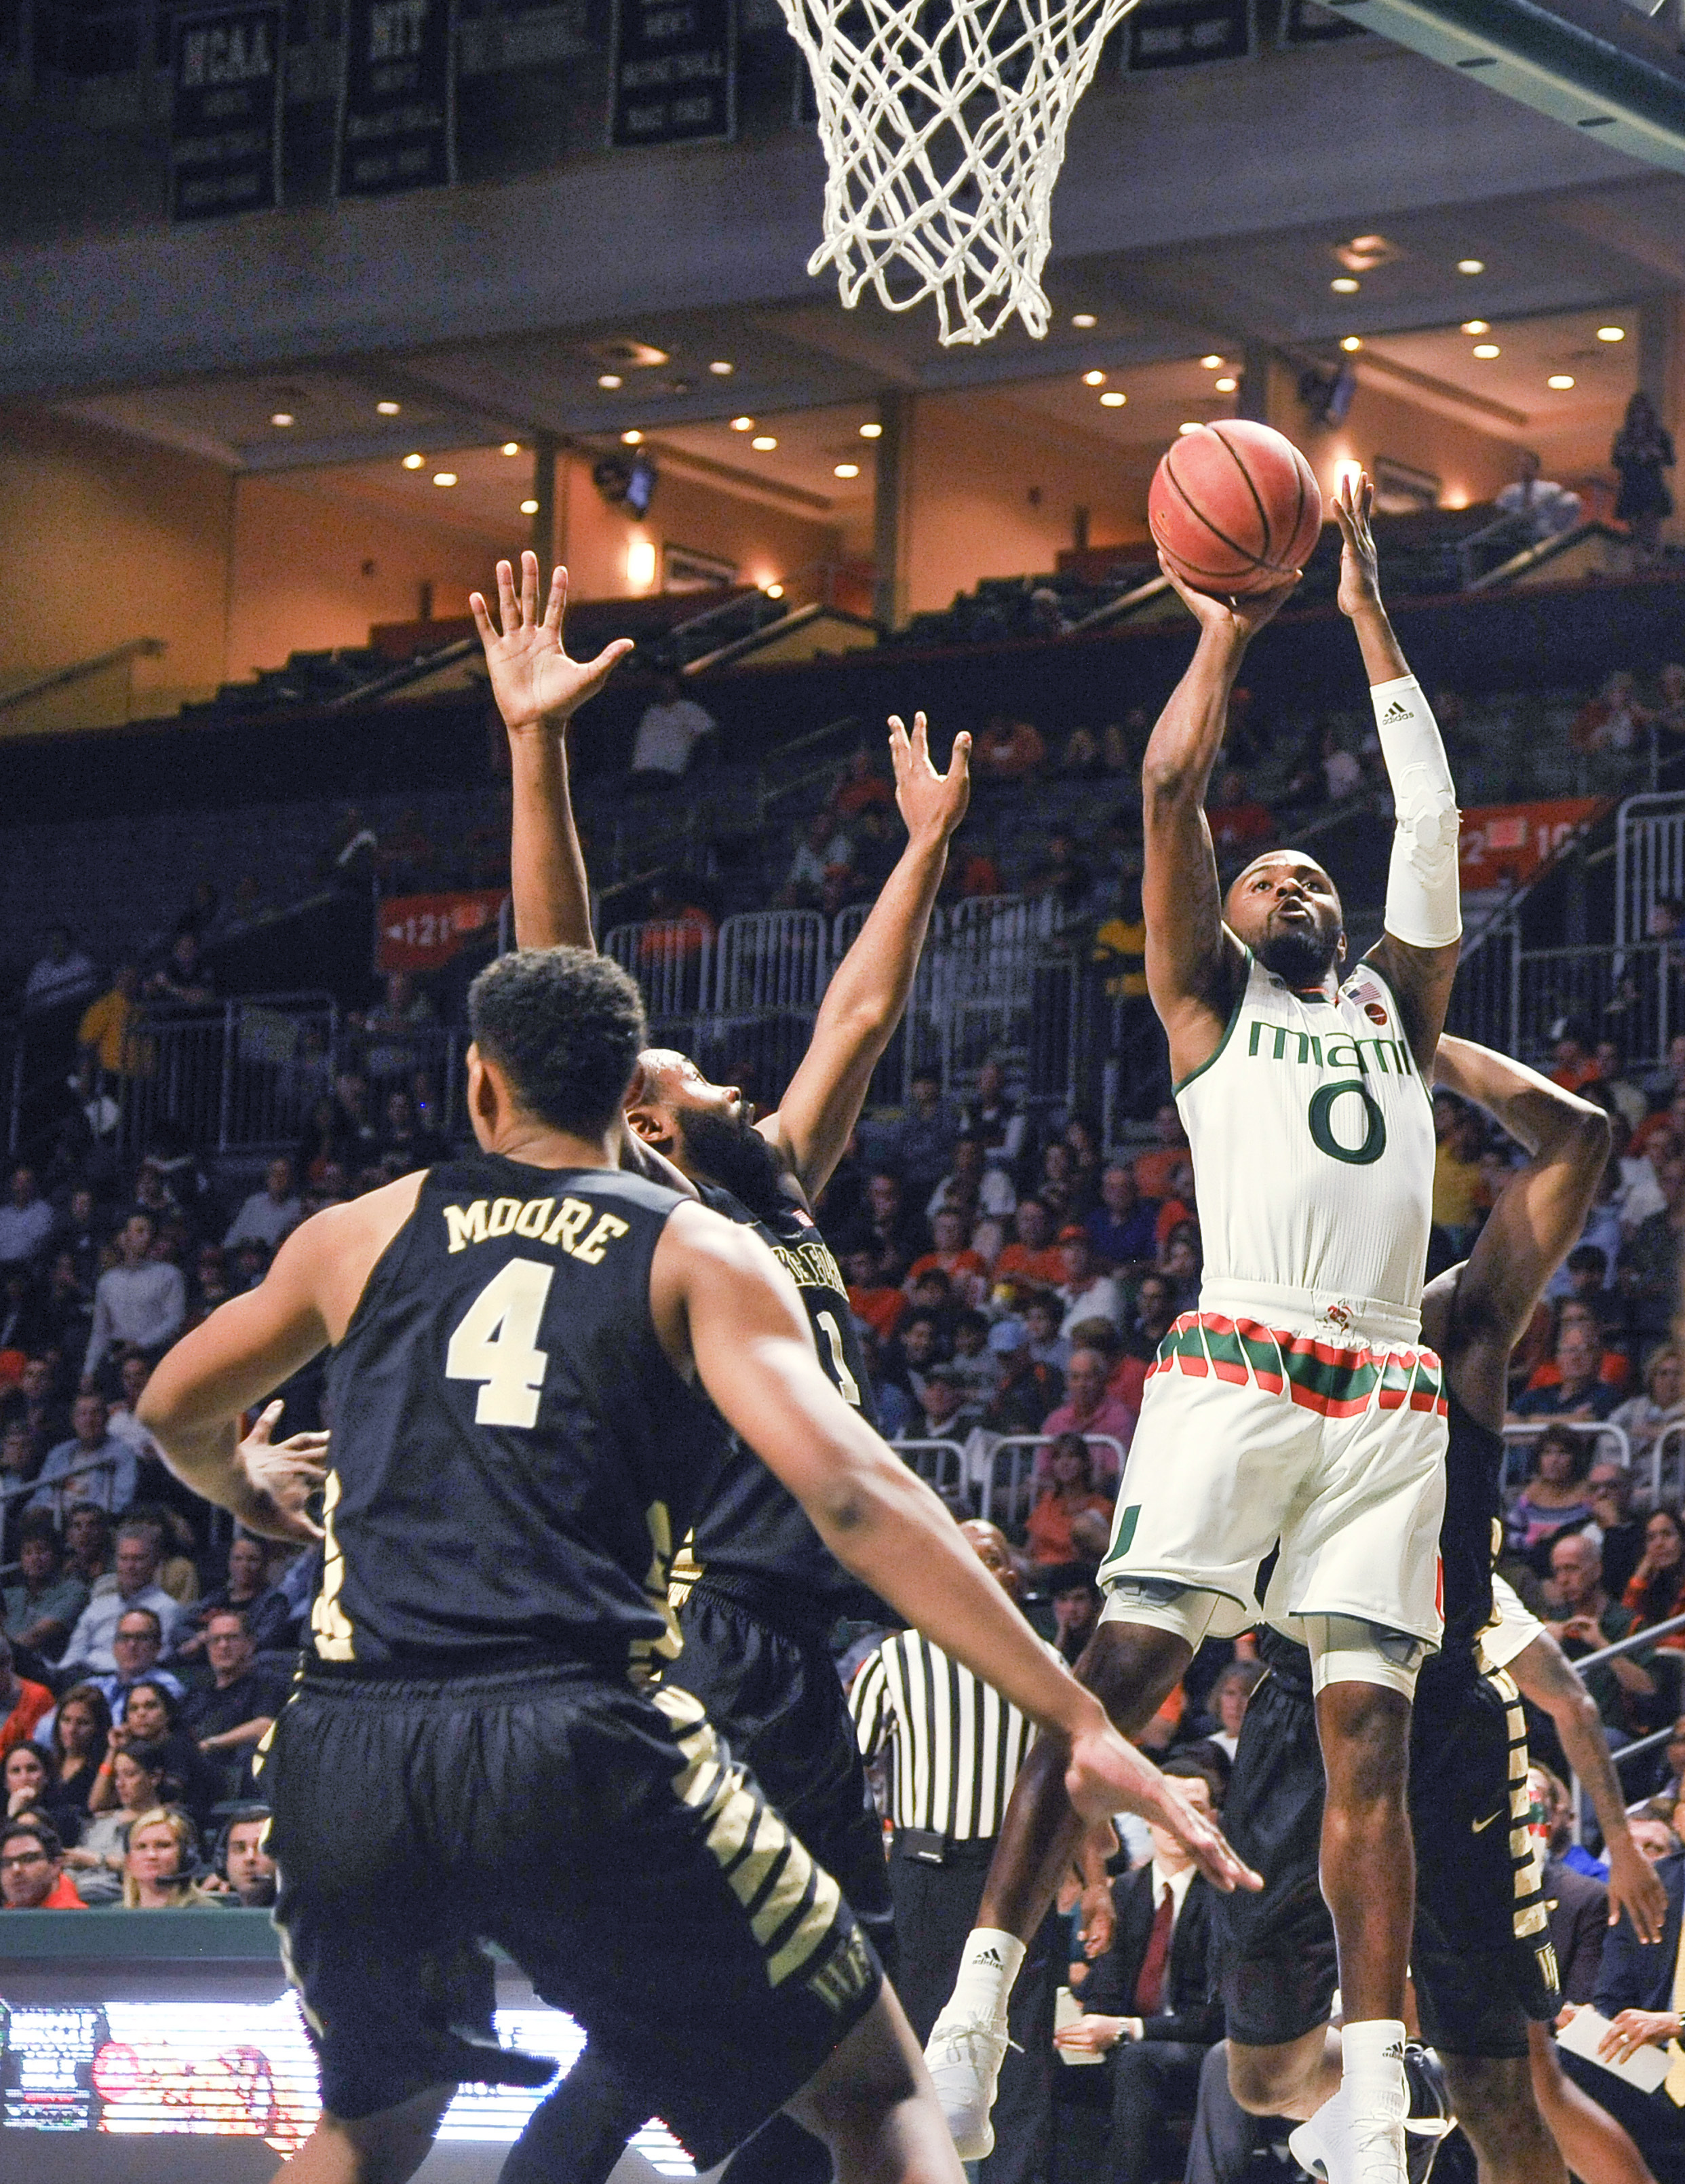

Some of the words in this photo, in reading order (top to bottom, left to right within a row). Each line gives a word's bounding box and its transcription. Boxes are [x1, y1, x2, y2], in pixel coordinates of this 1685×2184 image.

[406, 914, 449, 946] 121
[1309, 1079, 1387, 1166] 0
[443, 1197, 630, 1265] MOORE
[445, 1257, 556, 1429] 4
[816, 1311, 861, 1406] 1
